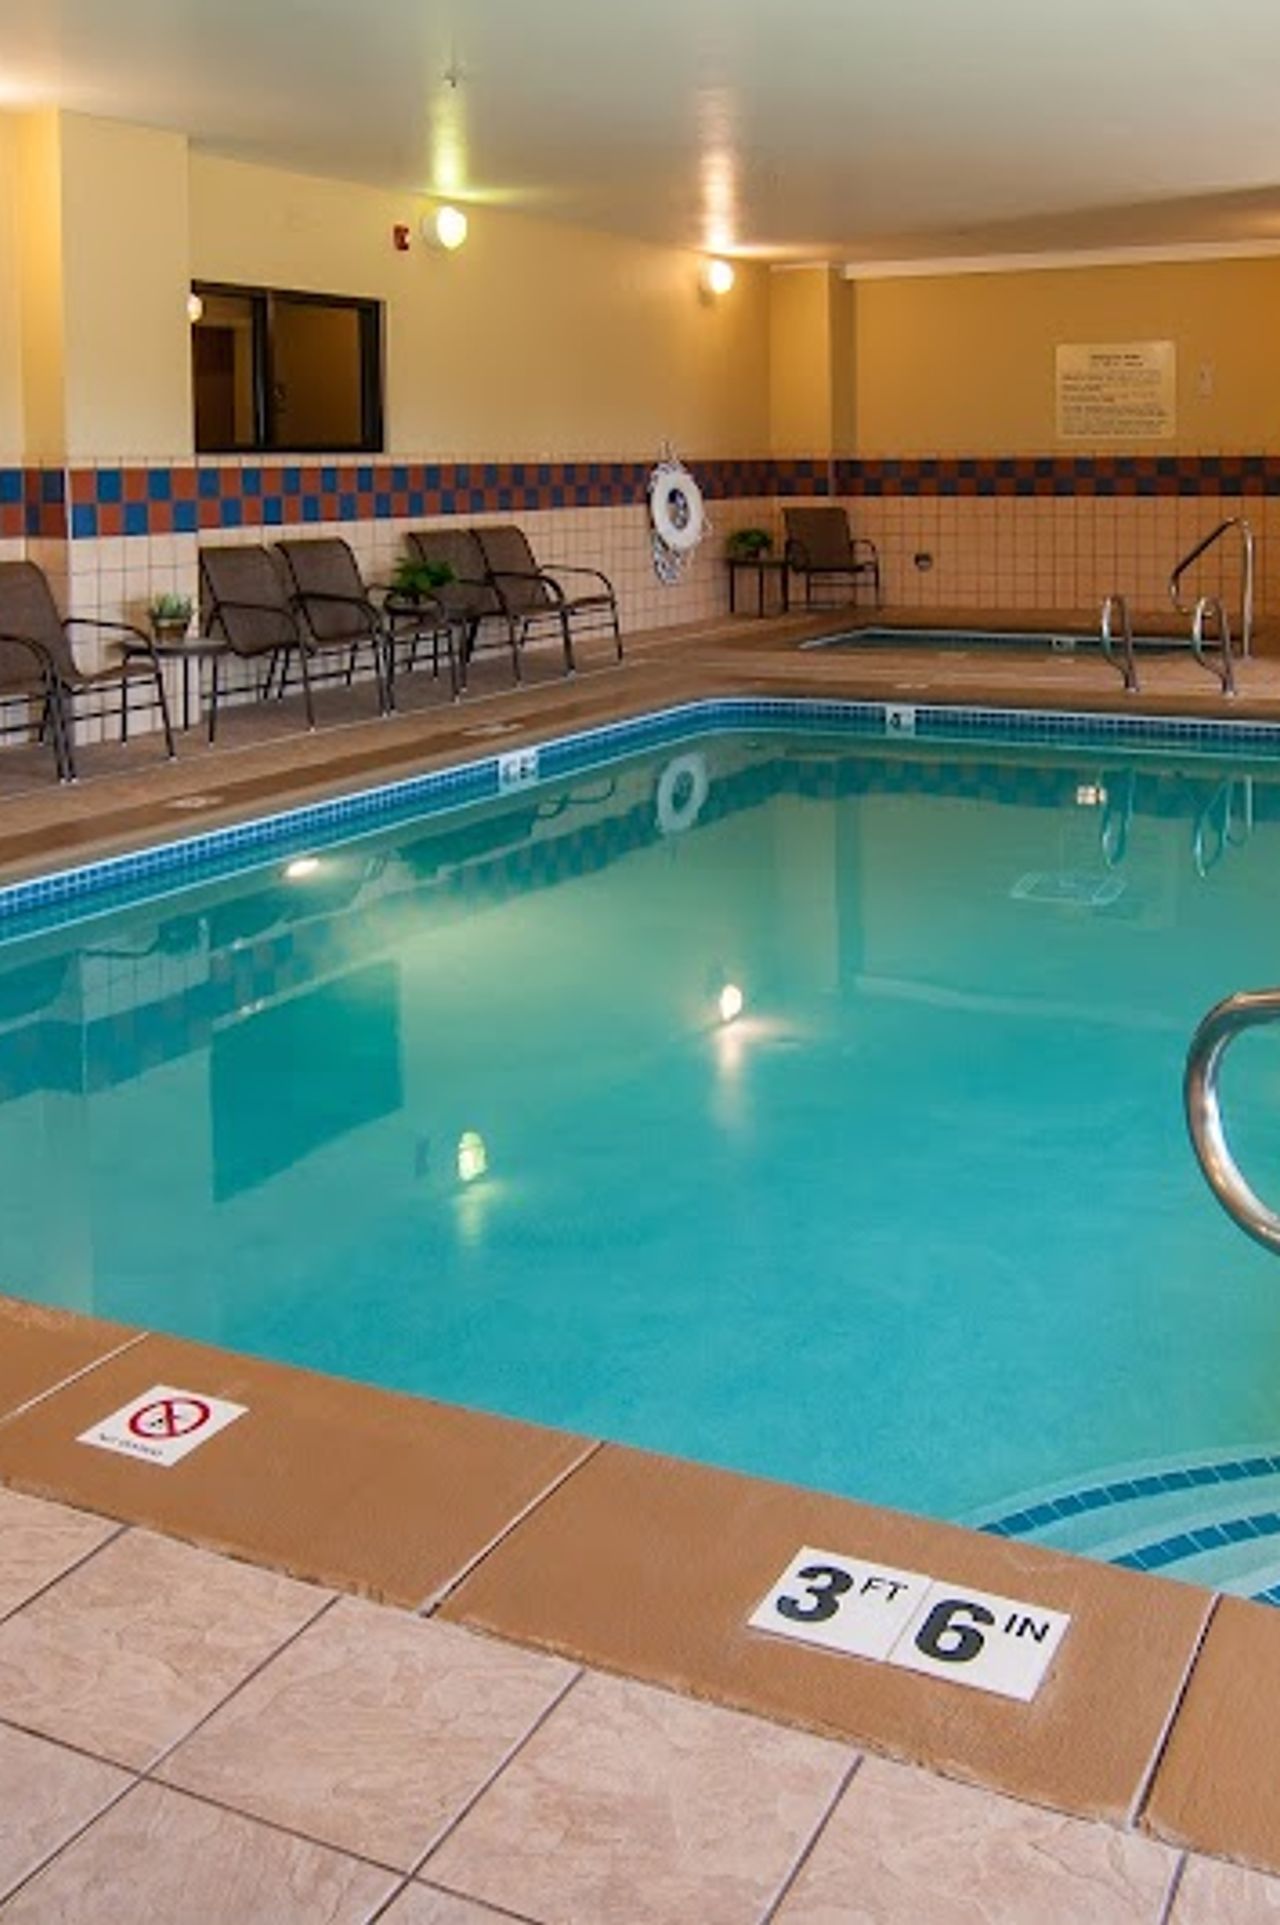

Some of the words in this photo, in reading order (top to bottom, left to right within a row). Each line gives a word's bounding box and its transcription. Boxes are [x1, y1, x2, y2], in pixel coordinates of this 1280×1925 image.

[776, 1566, 854, 1623] 3
[860, 1576, 908, 1602] FT
[914, 1599, 996, 1662] 6
[1004, 1613, 1050, 1643] IN
